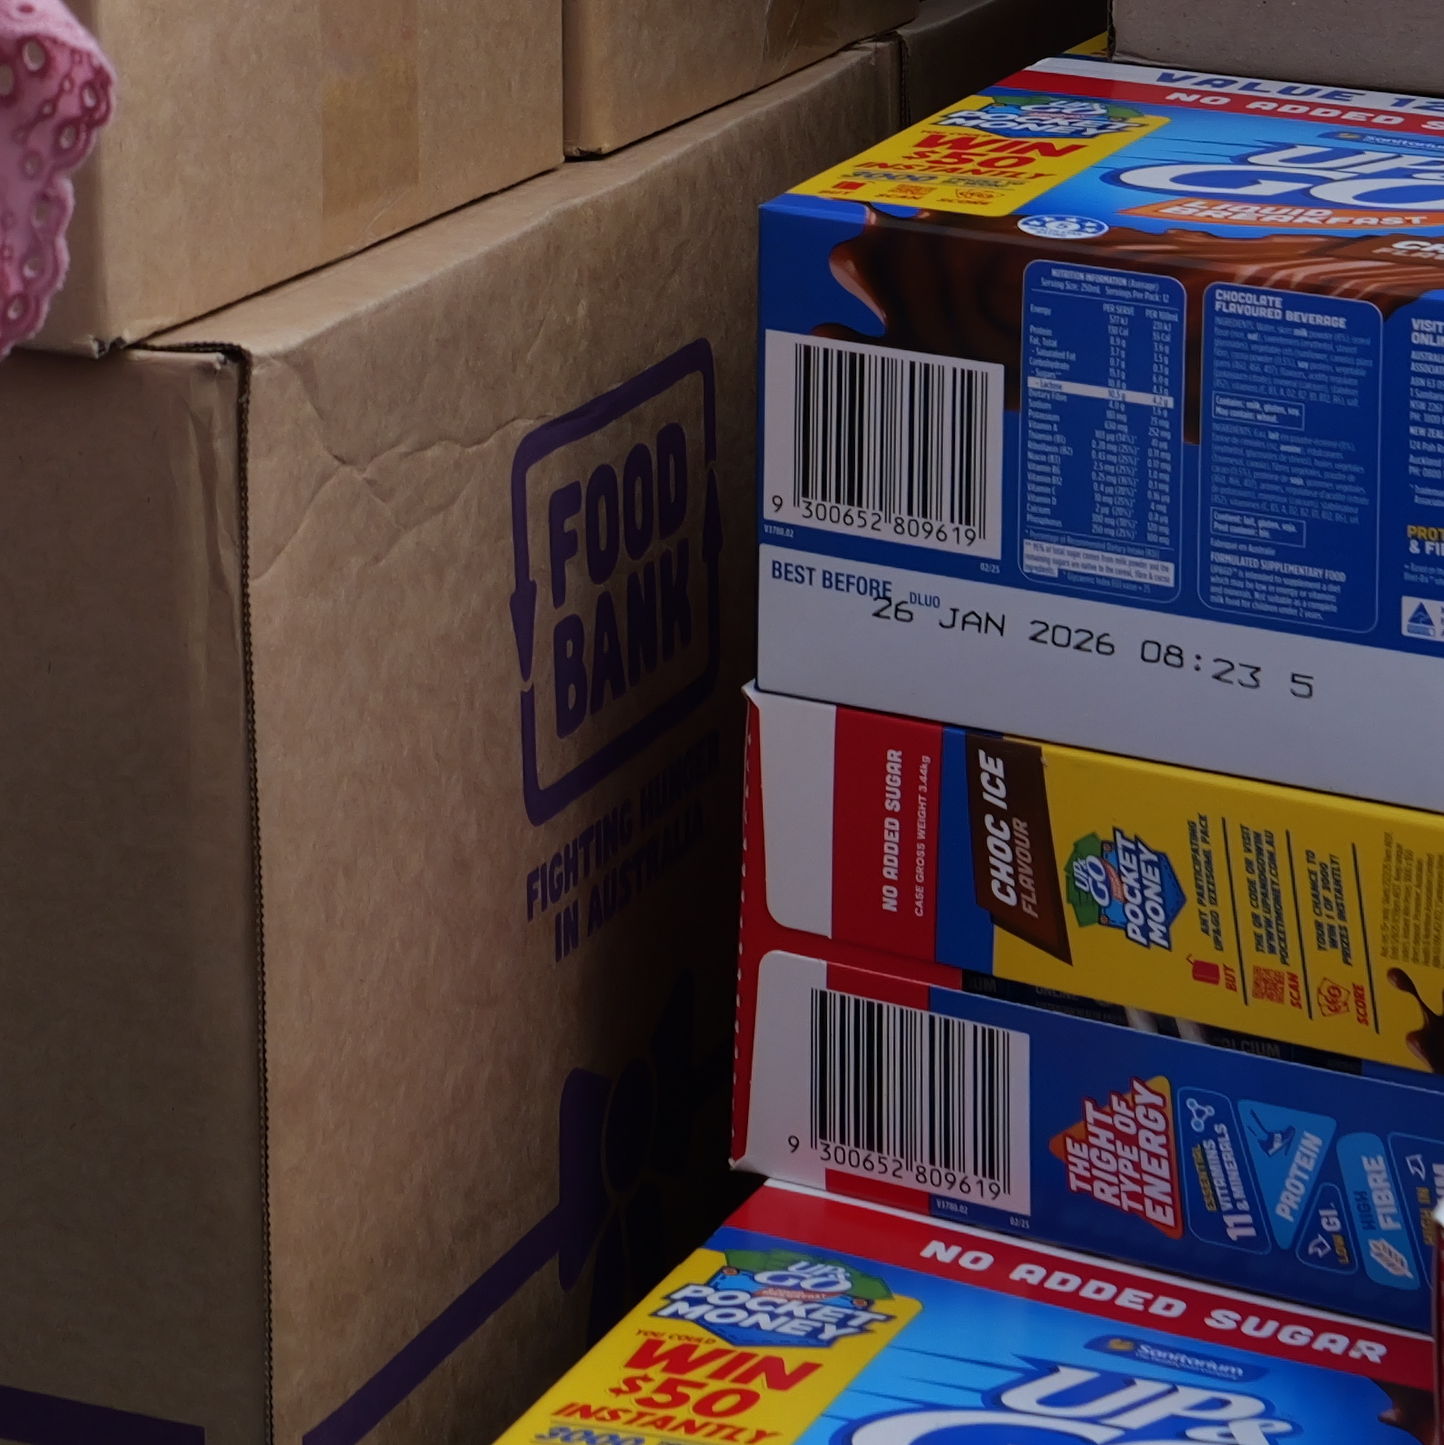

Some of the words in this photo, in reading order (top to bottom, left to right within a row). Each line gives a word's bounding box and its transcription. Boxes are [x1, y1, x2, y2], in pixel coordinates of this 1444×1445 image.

[1156, 72, 1368, 104] VALUE
[1166, 91, 1233, 107] NO
[1246, 99, 1404, 127] ADDED
[549, 422, 689, 610] FOOD
[801, 499, 882, 532] 300652
[892, 517, 978, 548] 809619
[771, 560, 816, 586] BEST
[822, 570, 893, 600] BEFORE
[552, 537, 691, 740] BANK
[872, 595, 914, 623] 26
[939, 607, 1006, 637] JAN
[1028, 619, 1115, 656] 2026
[1141, 640, 1262, 690] 08:23
[1290, 675, 1315, 699] 5
[884, 748, 903, 812] SUGAR
[978, 749, 1008, 810] ICE
[883, 820, 900, 880] ADDED
[984, 814, 1017, 906] CHOC
[882, 887, 899, 912] NO
[1133, 1080, 1176, 1228] ENERGY
[1275, 1131, 1323, 1223] PROTEIN
[1363, 1154, 1402, 1231] FIBRE
[919, 1239, 996, 1271] NO
[1010, 1264, 1187, 1318] ADDED
[1204, 1309, 1389, 1364] SUGAR
